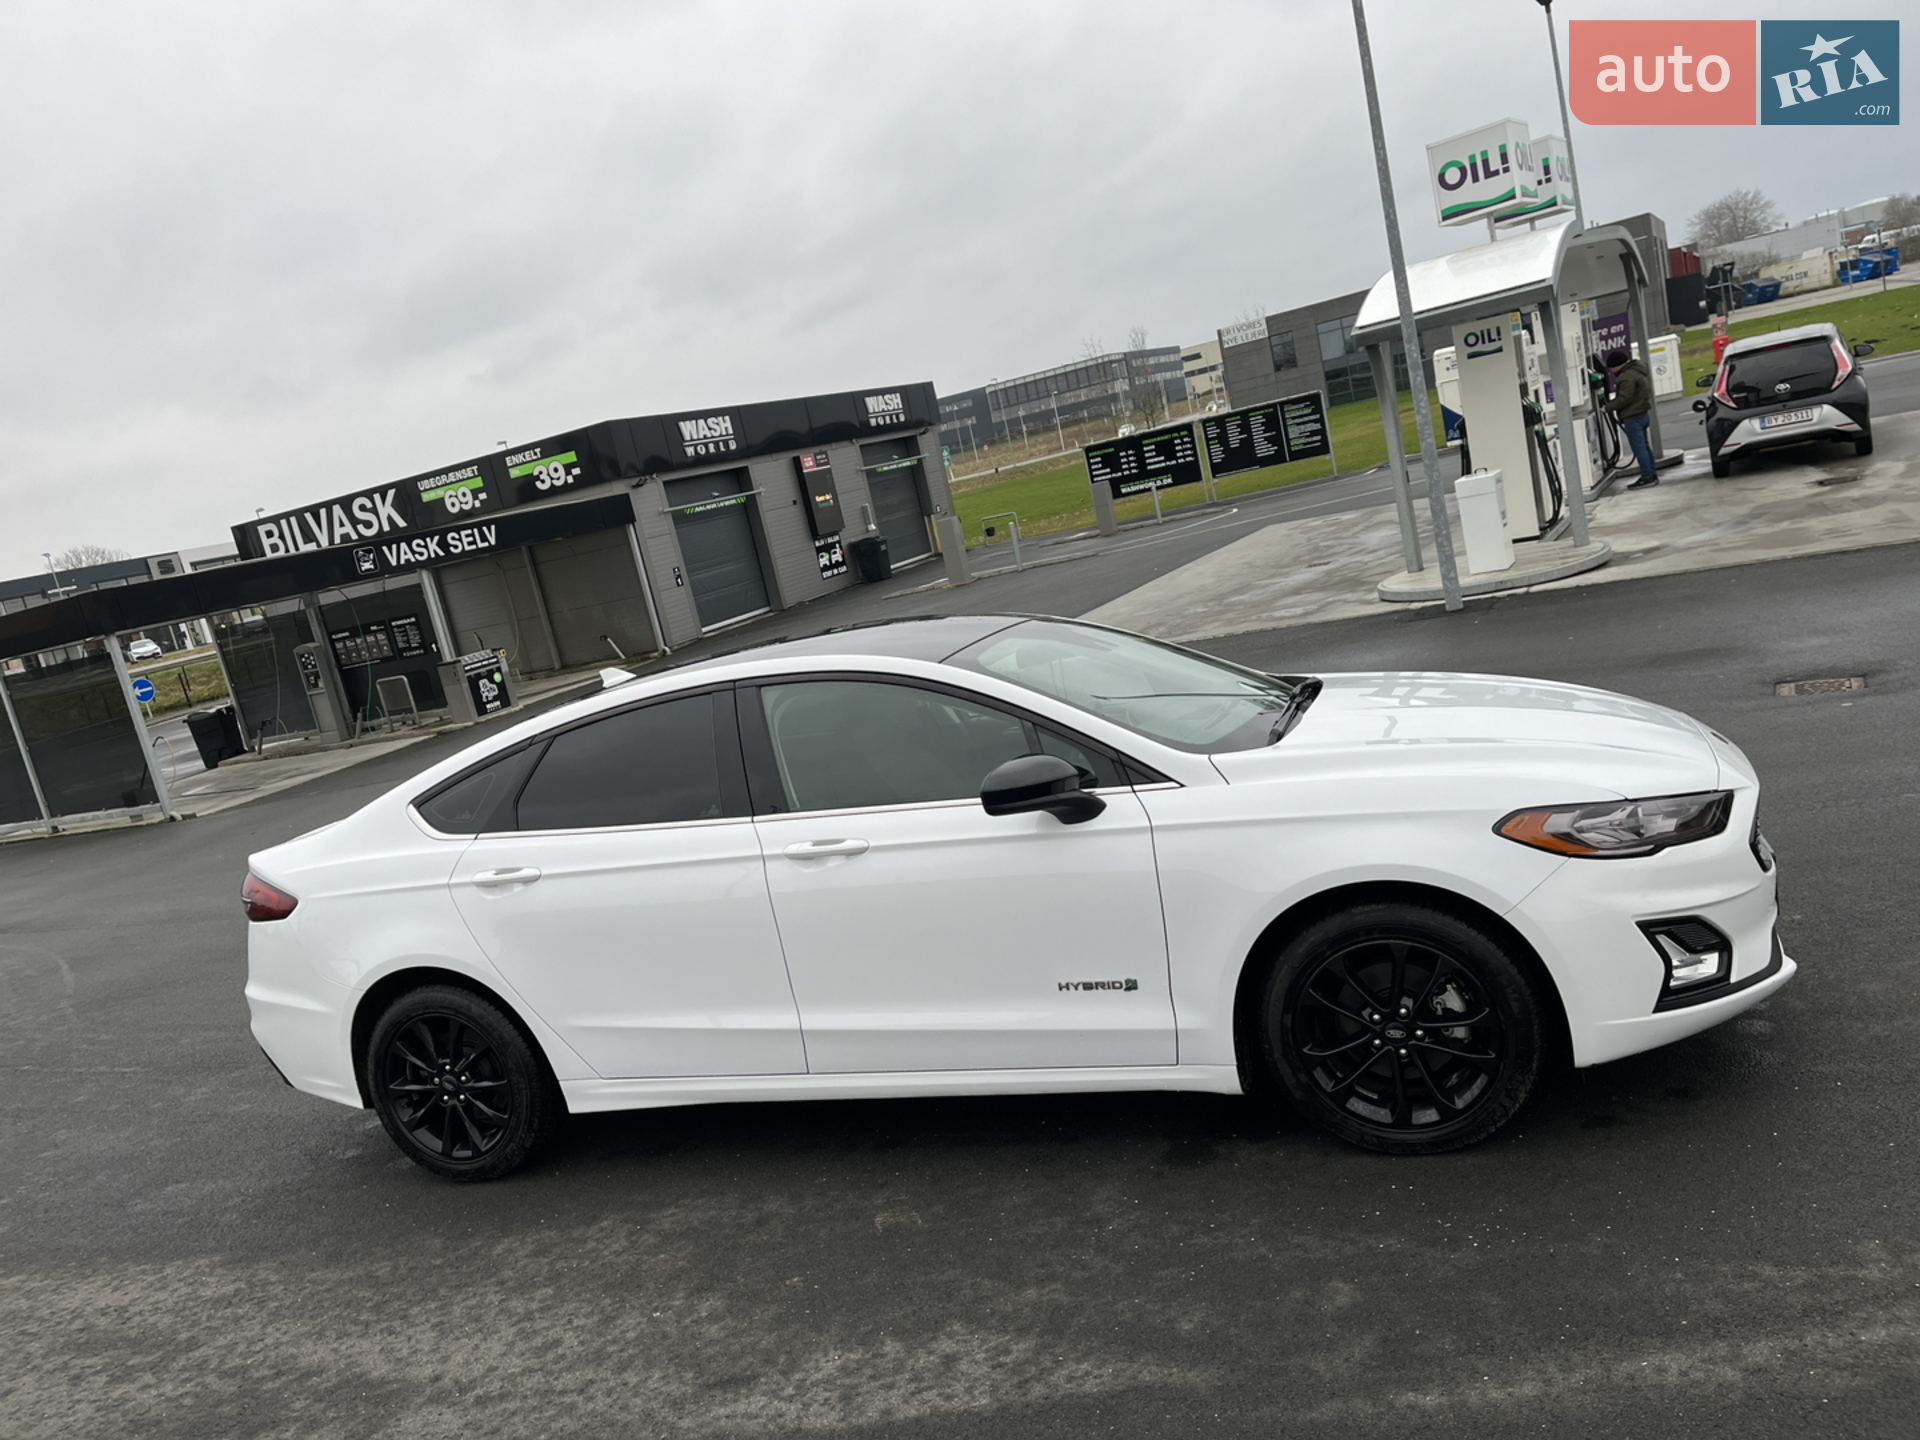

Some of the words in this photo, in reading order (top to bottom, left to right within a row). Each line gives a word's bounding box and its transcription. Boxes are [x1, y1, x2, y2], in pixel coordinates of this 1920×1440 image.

[1438, 143, 1510, 191] OIL!
[1570, 303, 1577, 312] 2
[1464, 326, 1502, 347] OIL!
[1610, 323, 1624, 334] en
[1224, 335, 1239, 346] NYE
[1600, 335, 1626, 351] ANK
[864, 393, 903, 413] WASH
[678, 415, 734, 441] WASH
[869, 413, 905, 427] WORLD
[505, 448, 541, 466] ENKELT
[684, 440, 737, 457] WORLD
[417, 465, 479, 491] UBEGRÆNSET
[257, 488, 408, 557] BILVASK
[382, 535, 445, 567] VASK
[447, 525, 496, 554] SELV
[1058, 980, 1123, 991] HYBRID
